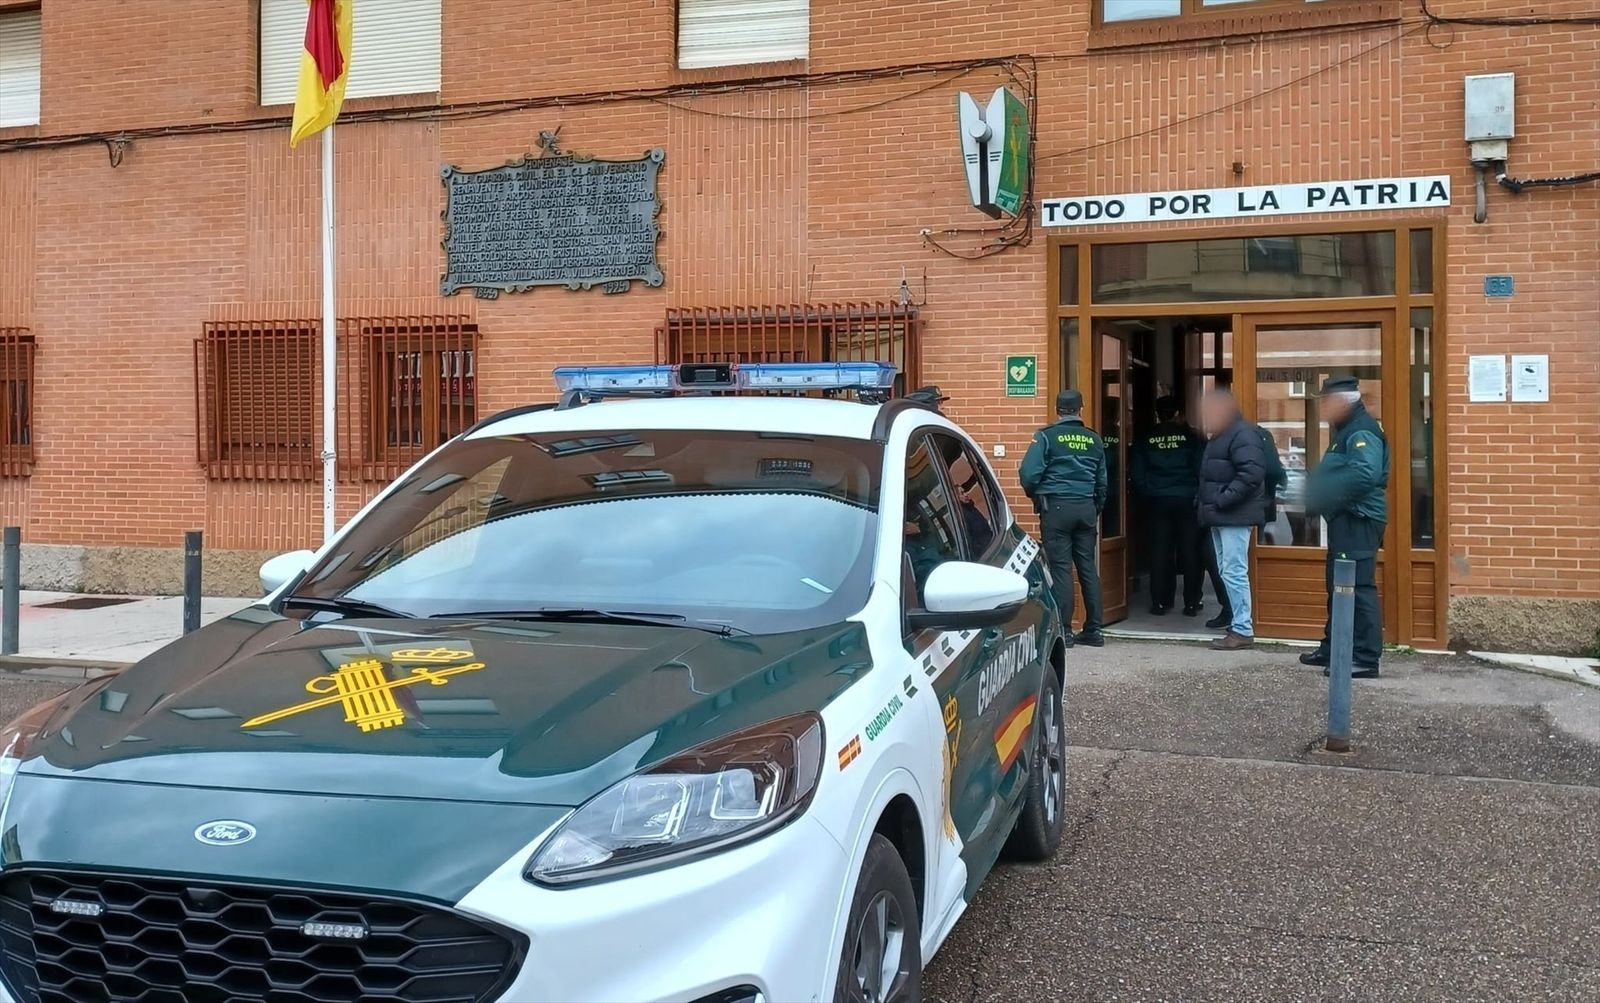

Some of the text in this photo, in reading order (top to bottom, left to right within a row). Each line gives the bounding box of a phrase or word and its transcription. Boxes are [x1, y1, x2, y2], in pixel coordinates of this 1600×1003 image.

[452, 182, 504, 195] BENAVENTE
[1044, 180, 1449, 222] TODO POR LA PATRIA
[1058, 434, 1094, 444] GUARDIA
[1069, 441, 1088, 450] CIVIL
[978, 624, 1038, 716] GUARDIA CIVIL
[865, 694, 904, 742] GUARDIA CIVIL
[206, 824, 244, 840] Ford
